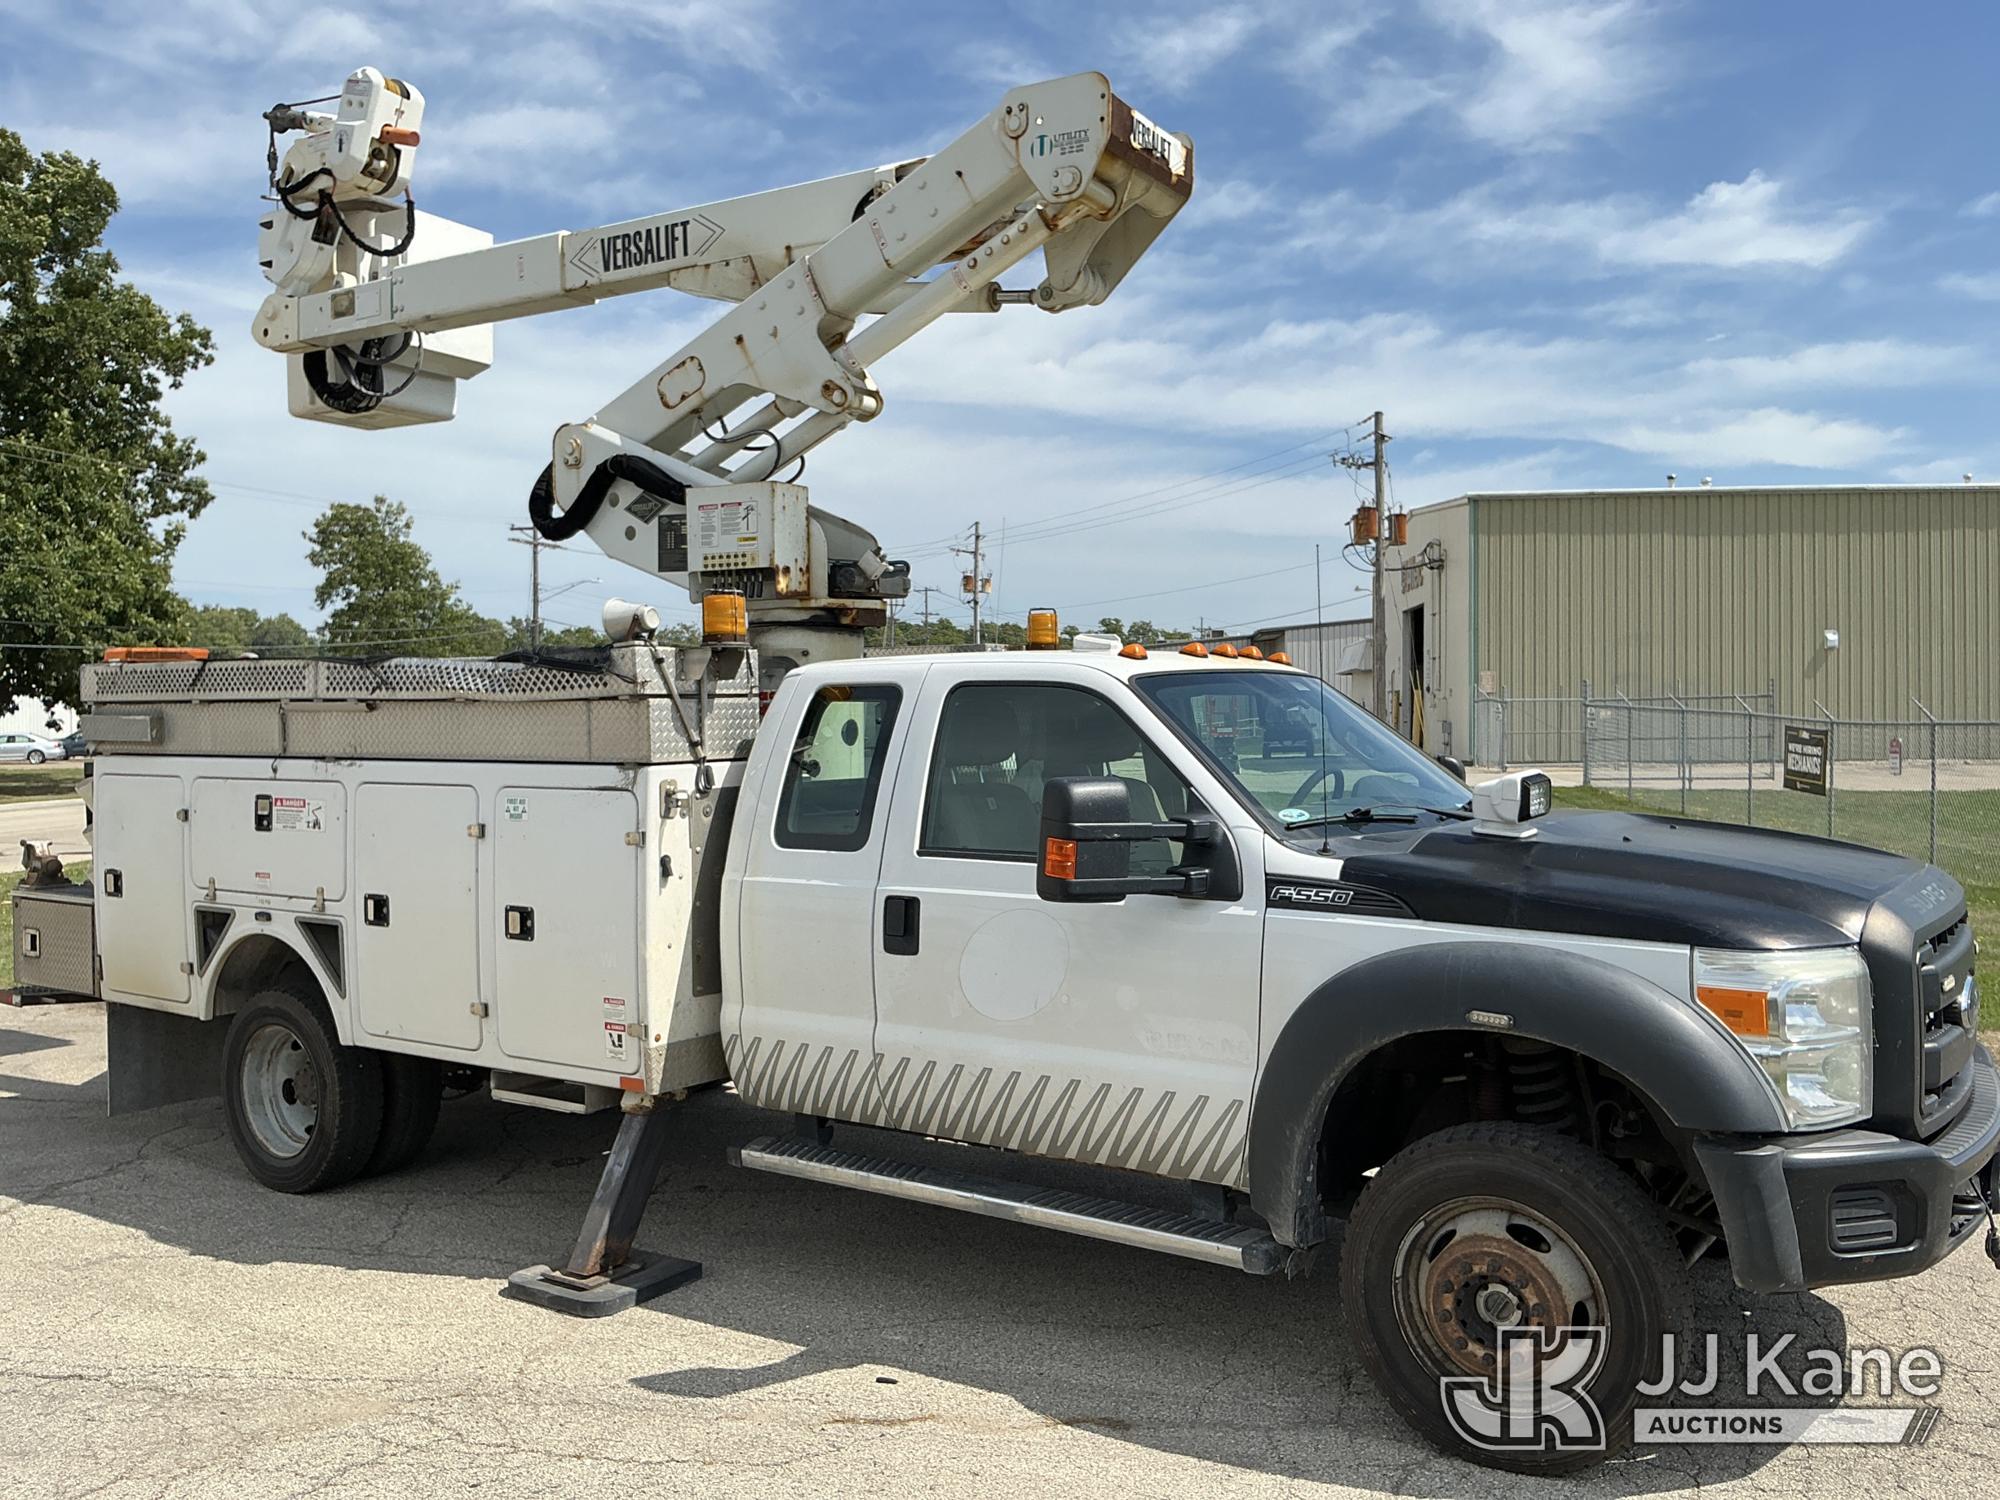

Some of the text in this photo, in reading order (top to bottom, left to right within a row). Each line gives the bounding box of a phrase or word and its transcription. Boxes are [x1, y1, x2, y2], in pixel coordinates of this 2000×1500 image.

[1053, 129, 1088, 142] UTILITY
[600, 220, 690, 272] VERSALIFT
[1802, 744, 1822, 756] HIRING
[1787, 752, 1821, 775] MECHANICS
[283, 799, 304, 807] DANGER
[1270, 886, 1353, 906] F-550
